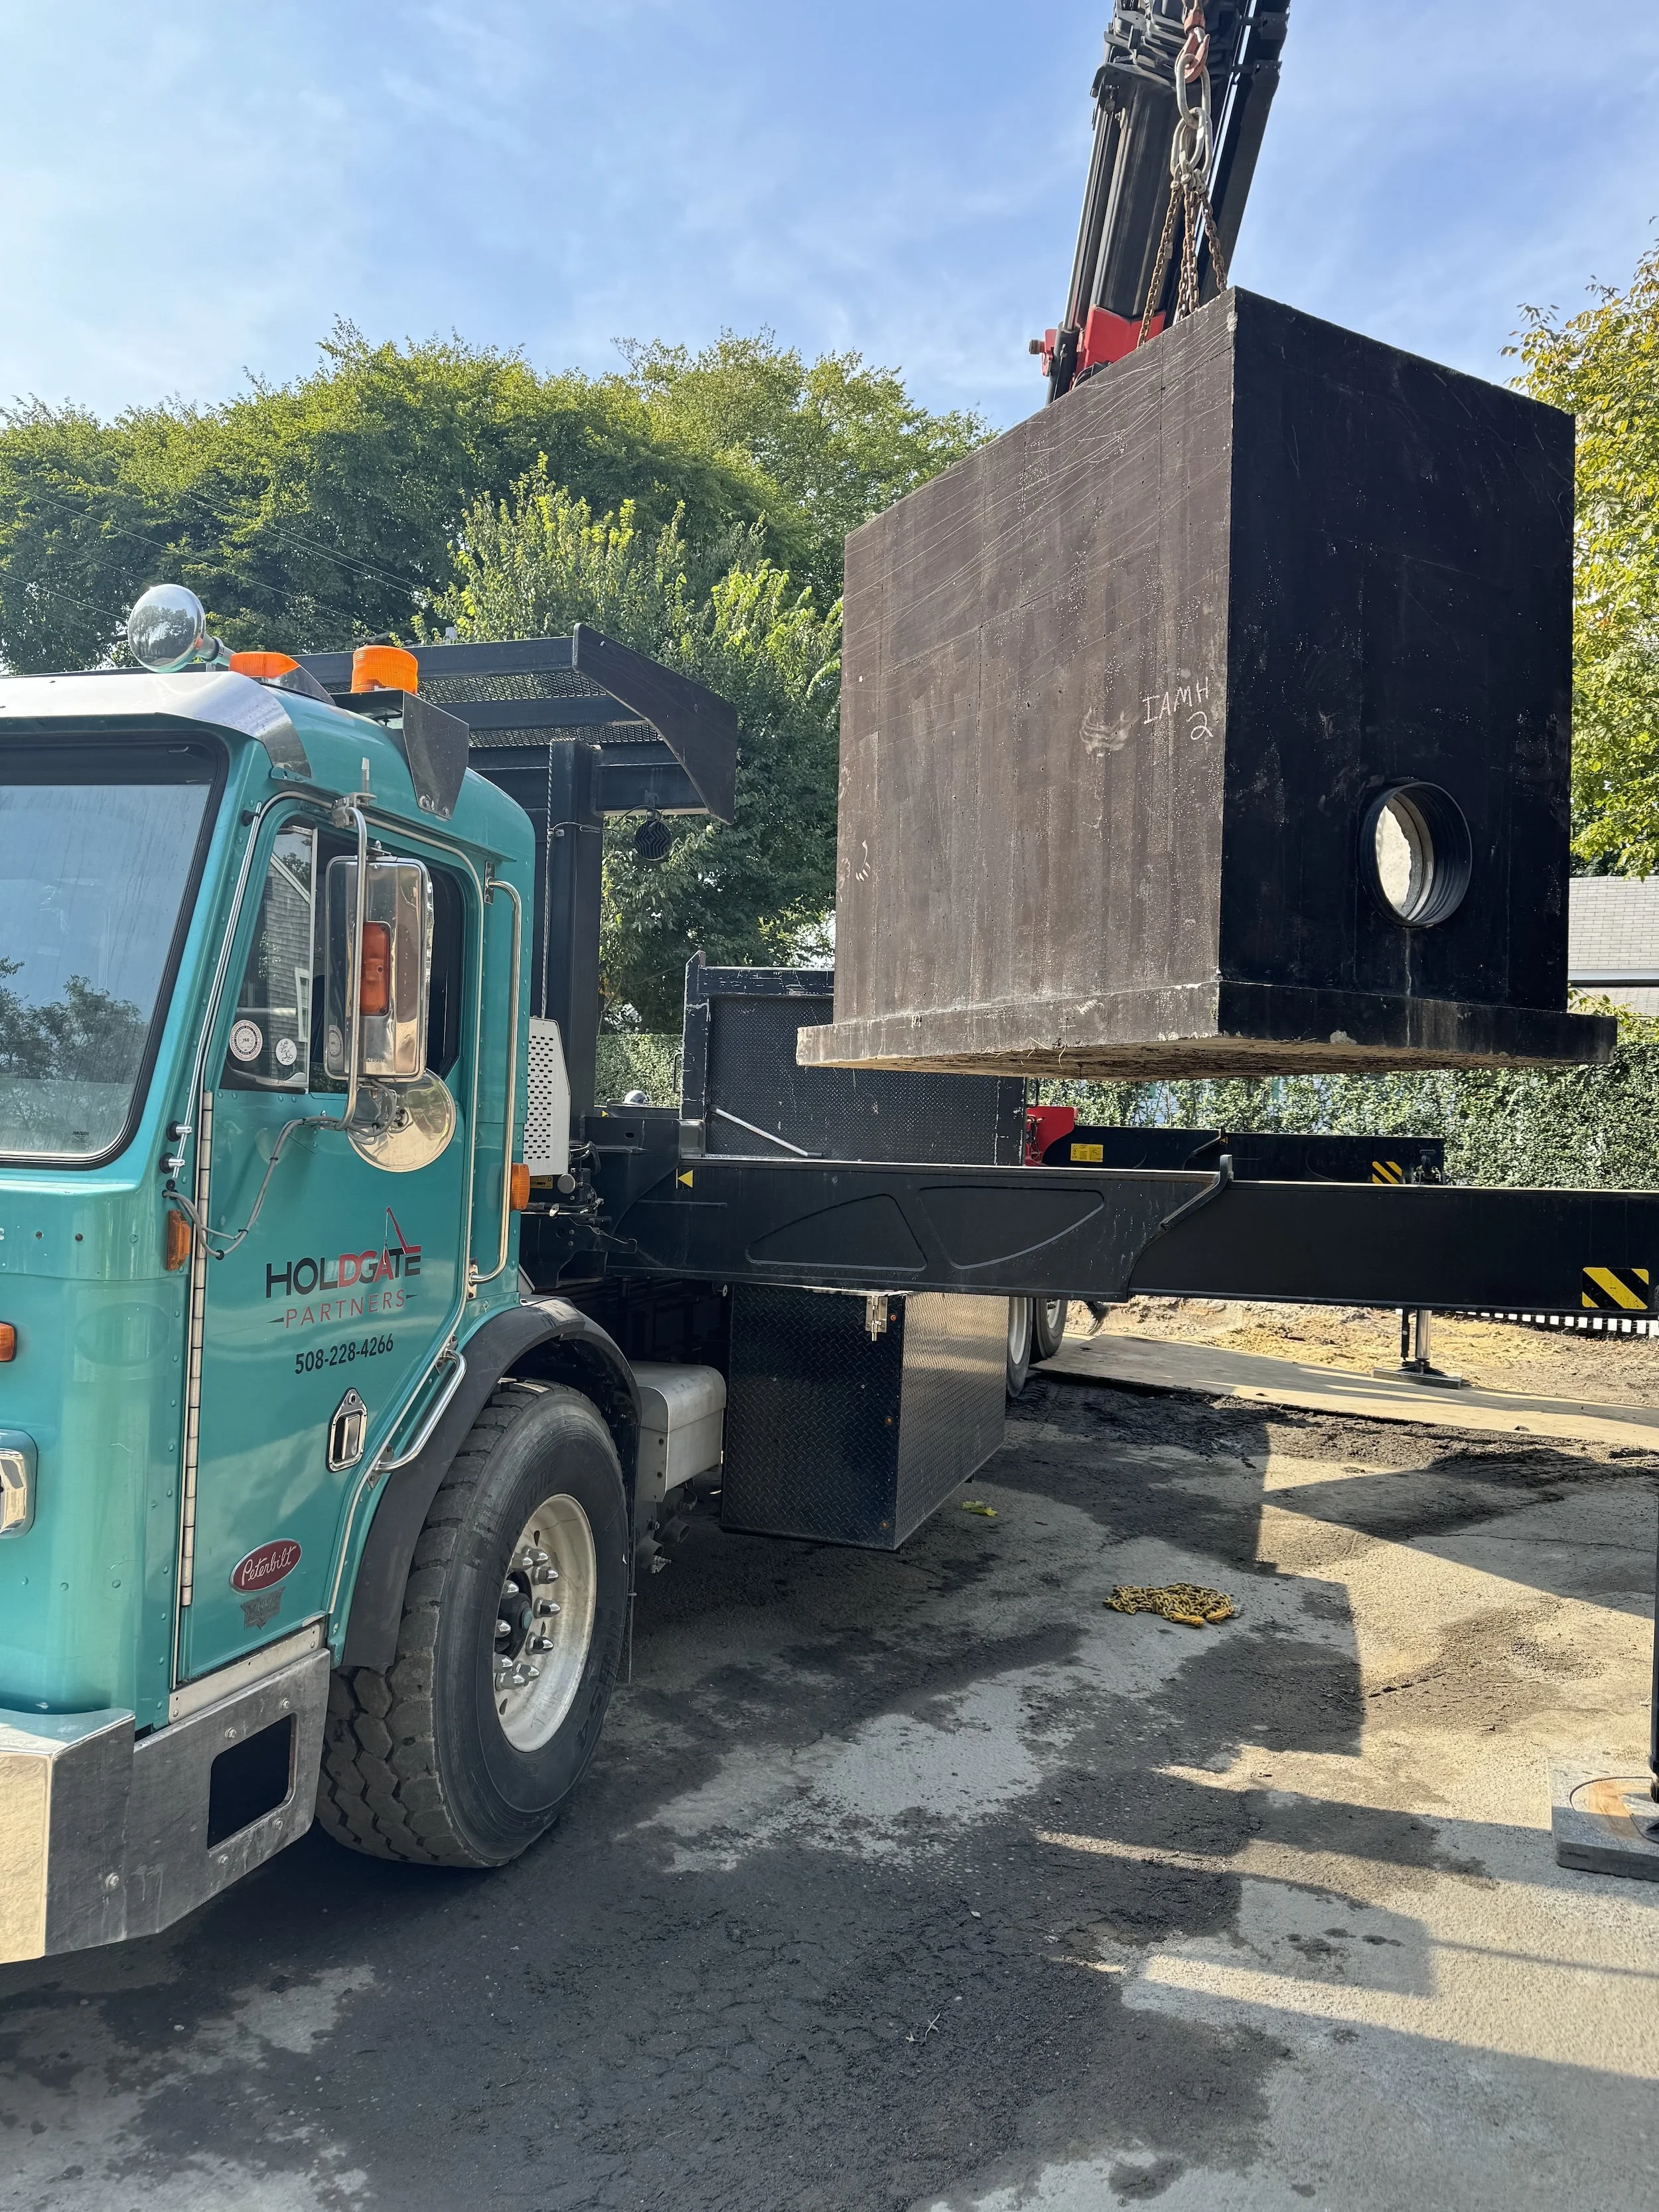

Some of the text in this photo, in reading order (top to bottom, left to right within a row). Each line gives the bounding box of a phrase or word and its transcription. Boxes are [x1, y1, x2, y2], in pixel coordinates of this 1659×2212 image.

[1186, 711, 1214, 740] 2
[266, 1245, 421, 1298] HOLDGATE
[285, 1289, 404, 1328] PARTNERS
[295, 1333, 394, 1374] 508-228-4266
[241, 1545, 297, 1586] Peterbilt
